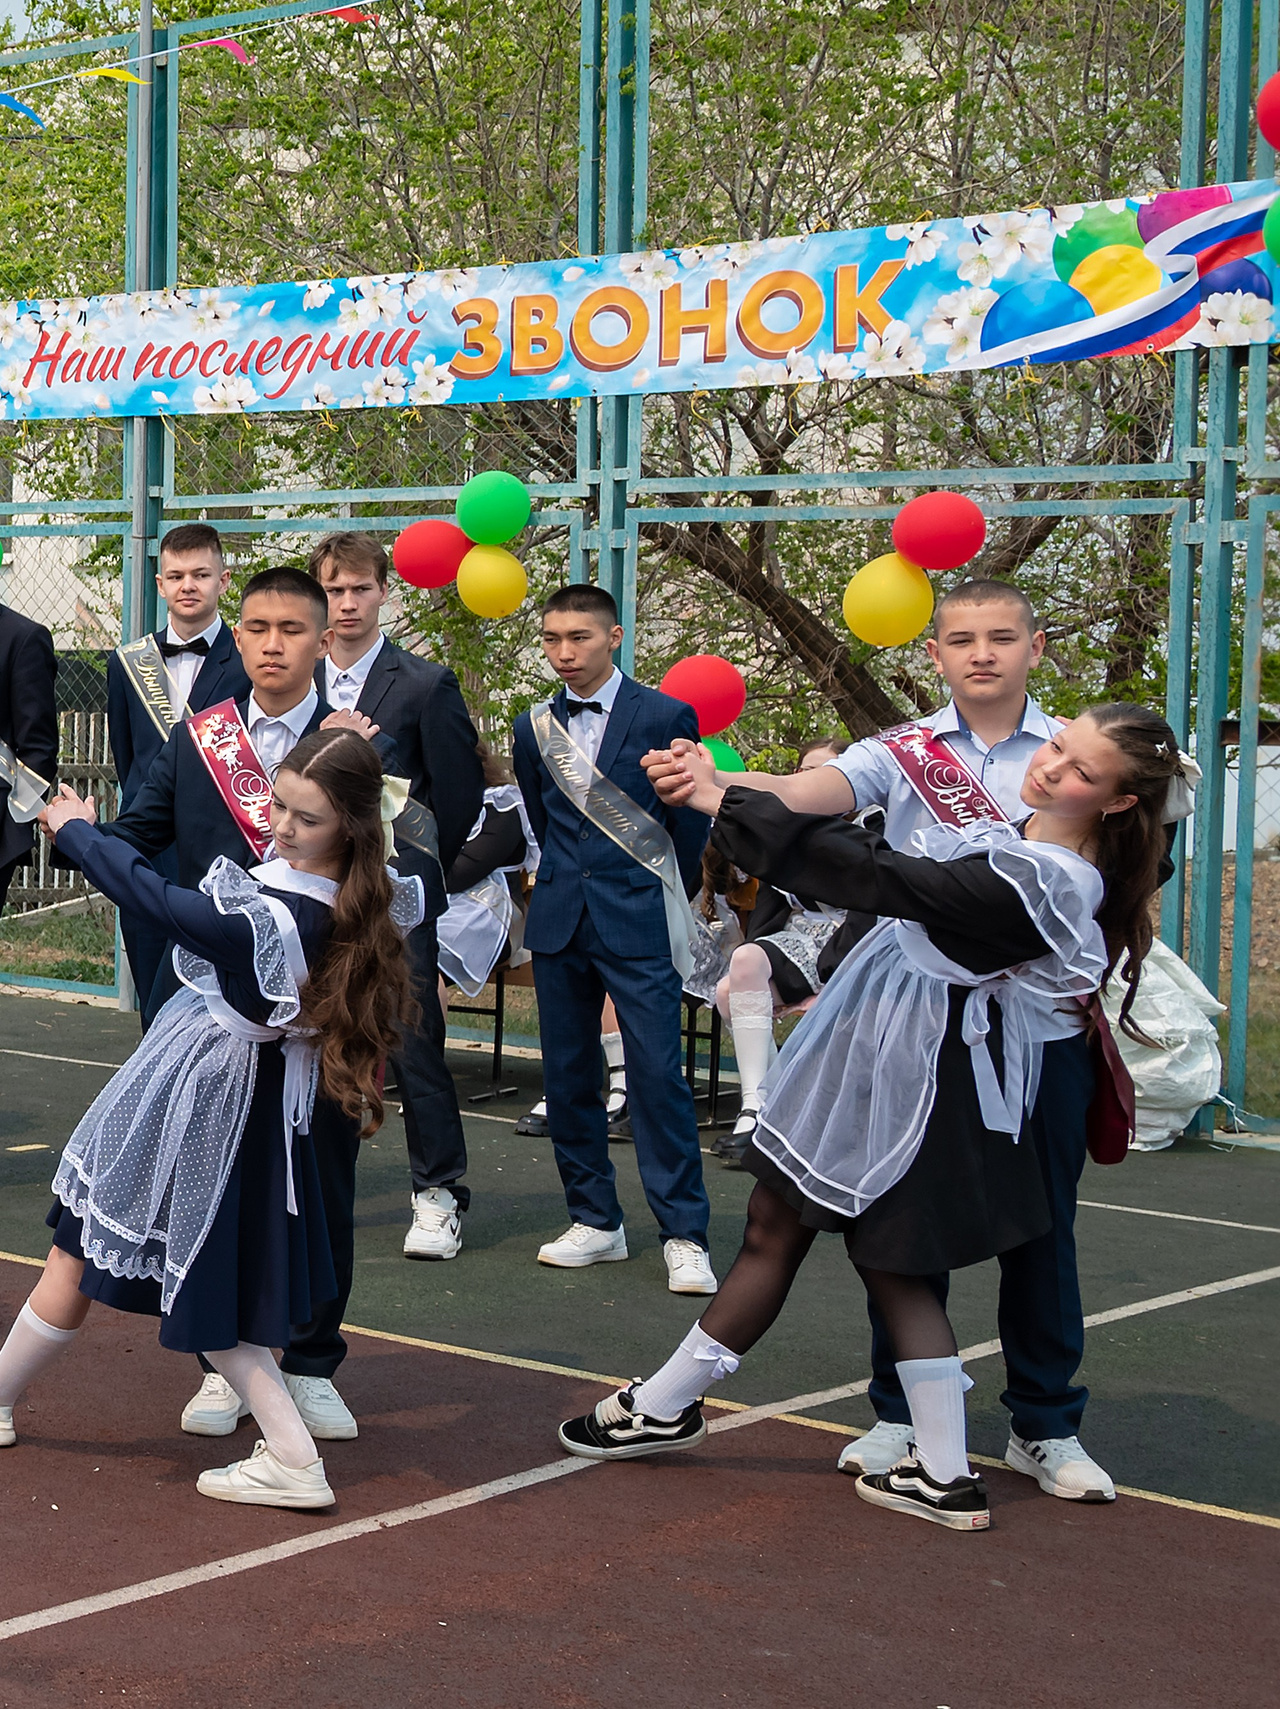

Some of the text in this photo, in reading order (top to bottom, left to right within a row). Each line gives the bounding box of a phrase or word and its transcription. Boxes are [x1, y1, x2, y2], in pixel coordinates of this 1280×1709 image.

[22, 258, 908, 400] Наш последний ЗВОНОК
[230, 768, 274, 845] Выпу
